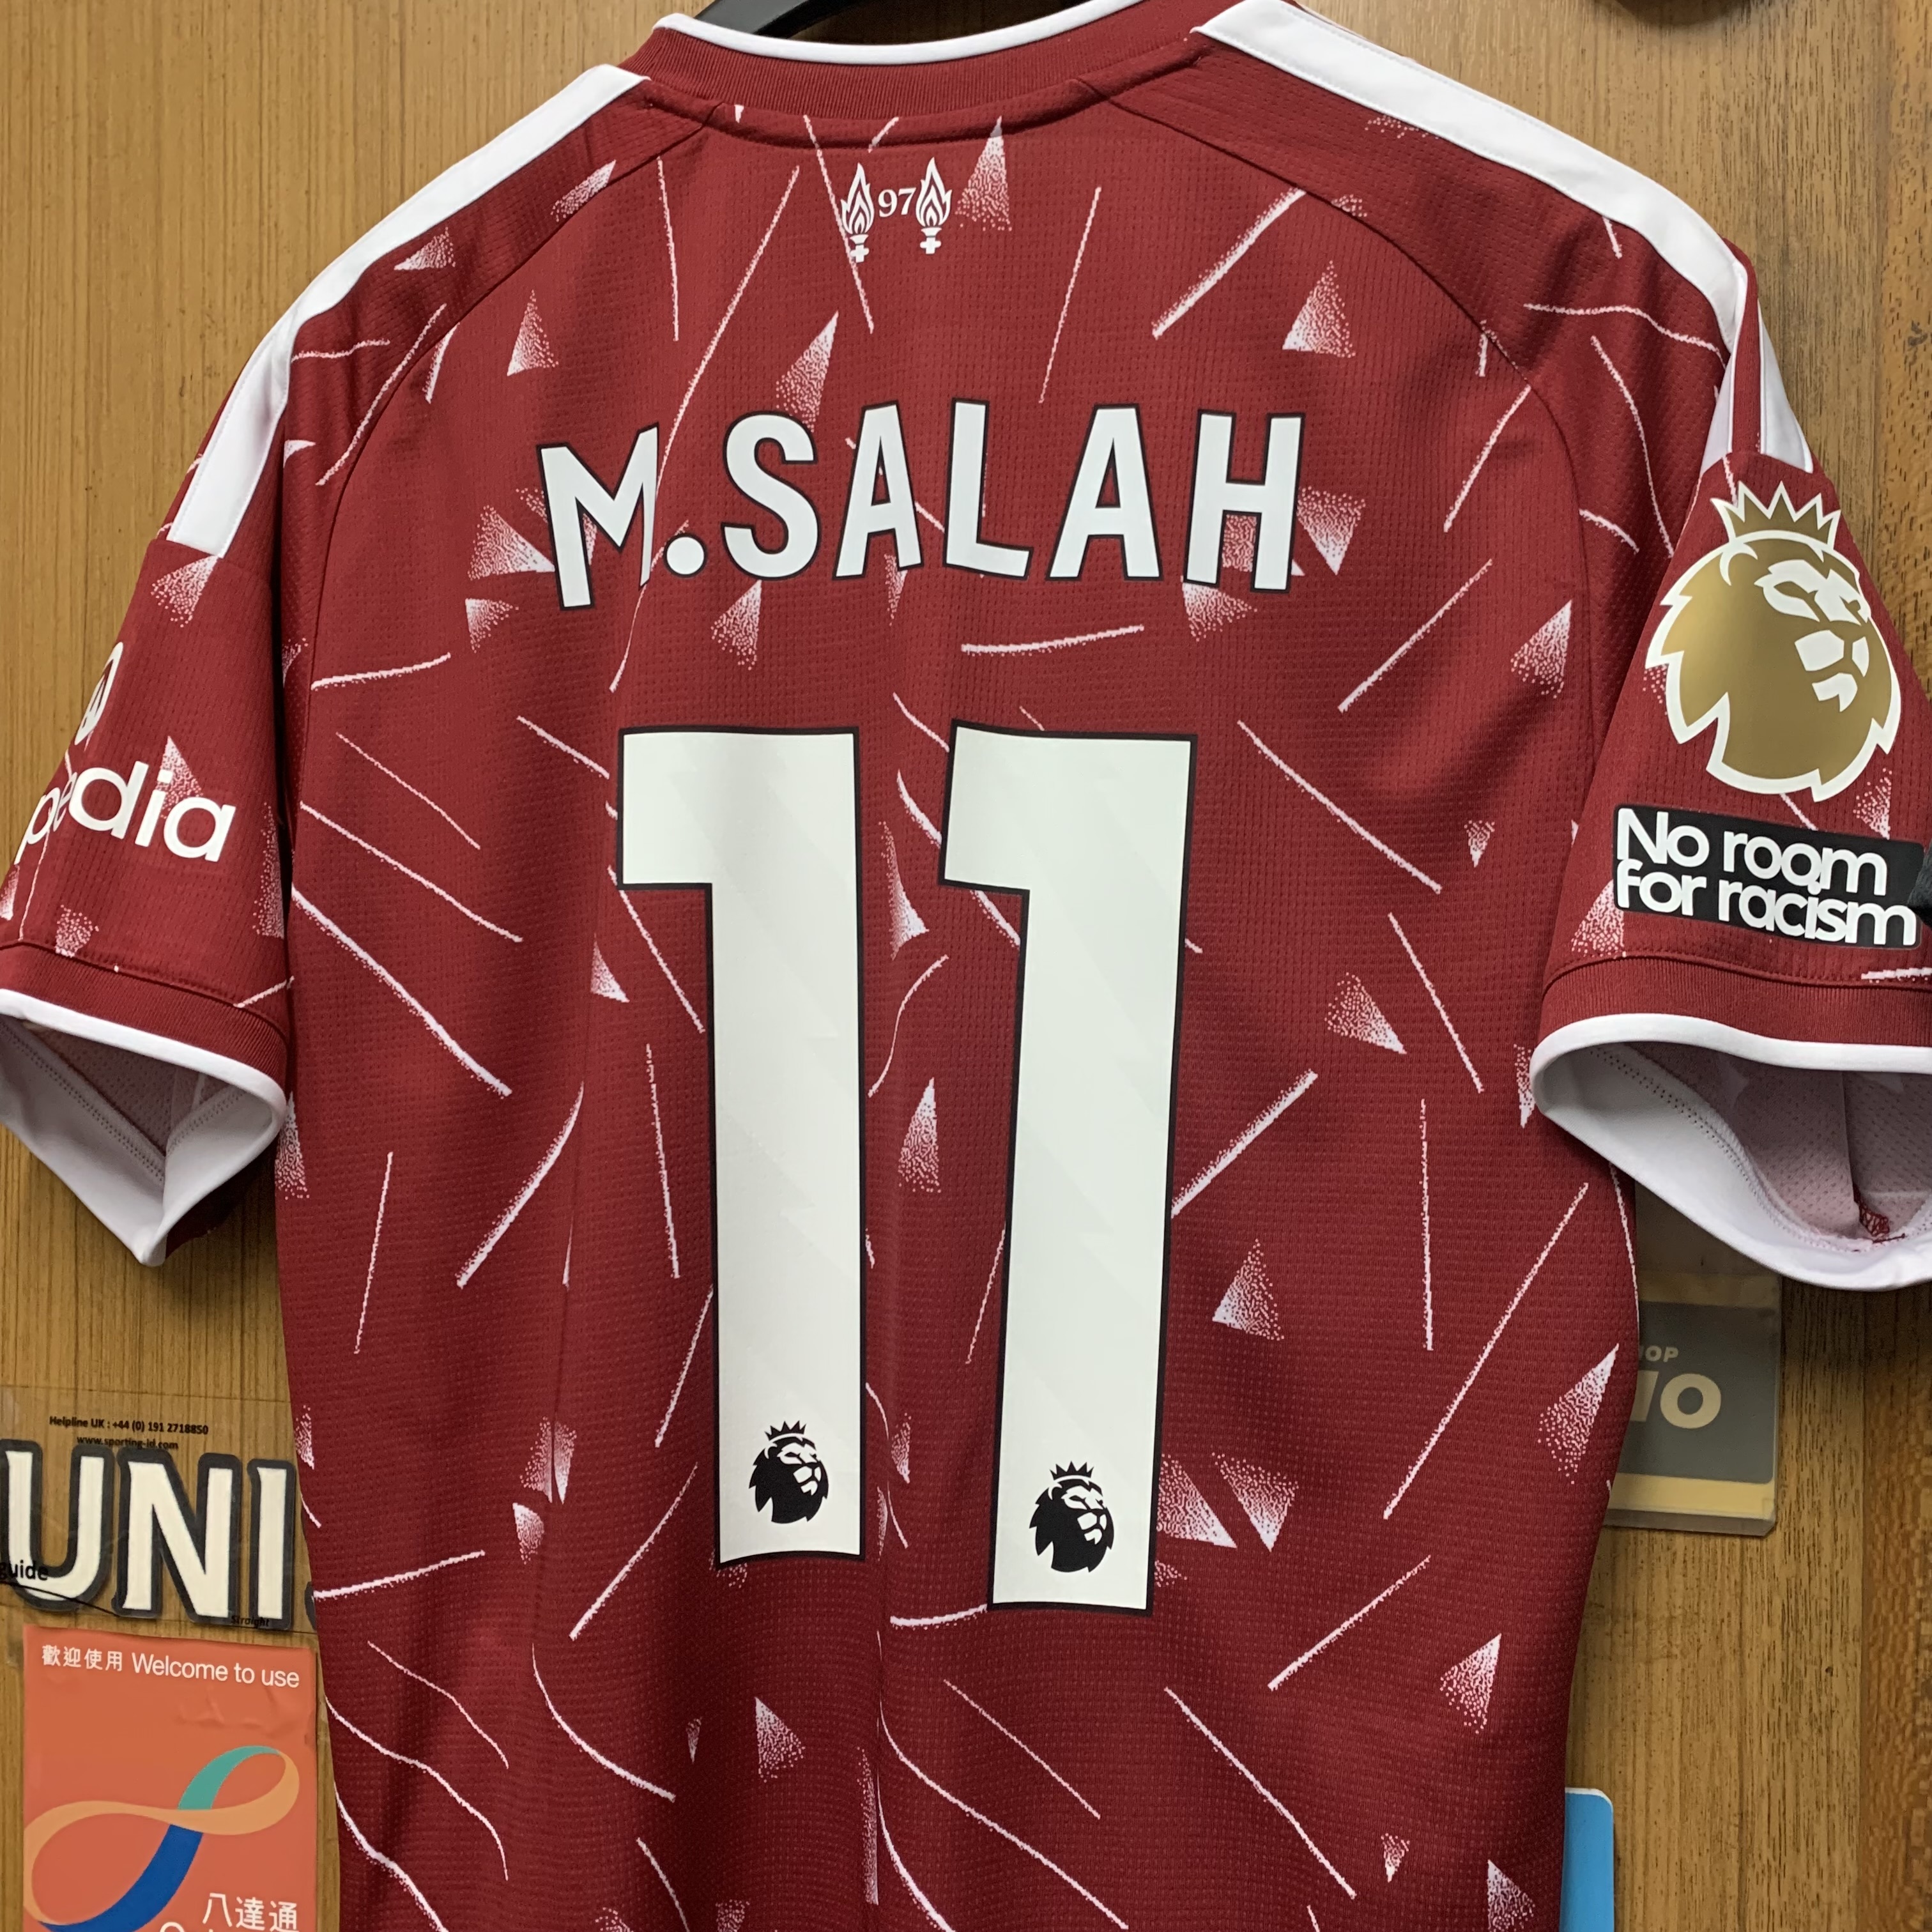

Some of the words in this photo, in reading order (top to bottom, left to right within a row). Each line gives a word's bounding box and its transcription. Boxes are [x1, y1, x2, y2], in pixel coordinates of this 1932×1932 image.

[878, 187, 916, 217] 97
[538, 399, 1305, 609] M.SALAH
[1617, 808, 1710, 867] No
[1723, 831, 1887, 896] room
[1617, 859, 1706, 916] for
[1718, 880, 1917, 946] racism
[618, 722, 1197, 1613] 11
[49, 1416, 88, 1428] Helpline
[91, 1418, 104, 1429] UK
[112, 1420, 130, 1430] +44
[132, 1421, 145, 1432] (0)
[148, 1422, 164, 1432] 191
[77, 1437, 178, 1450] www.sporting-id.com
[0, 1439, 317, 1630] UNI
[42, 1644, 123, 1671] 歡迎使用
[132, 1652, 228, 1682] Welcome
[234, 1662, 256, 1685] to
[261, 1670, 300, 1688] use
[203, 1892, 300, 1932] 八達通
